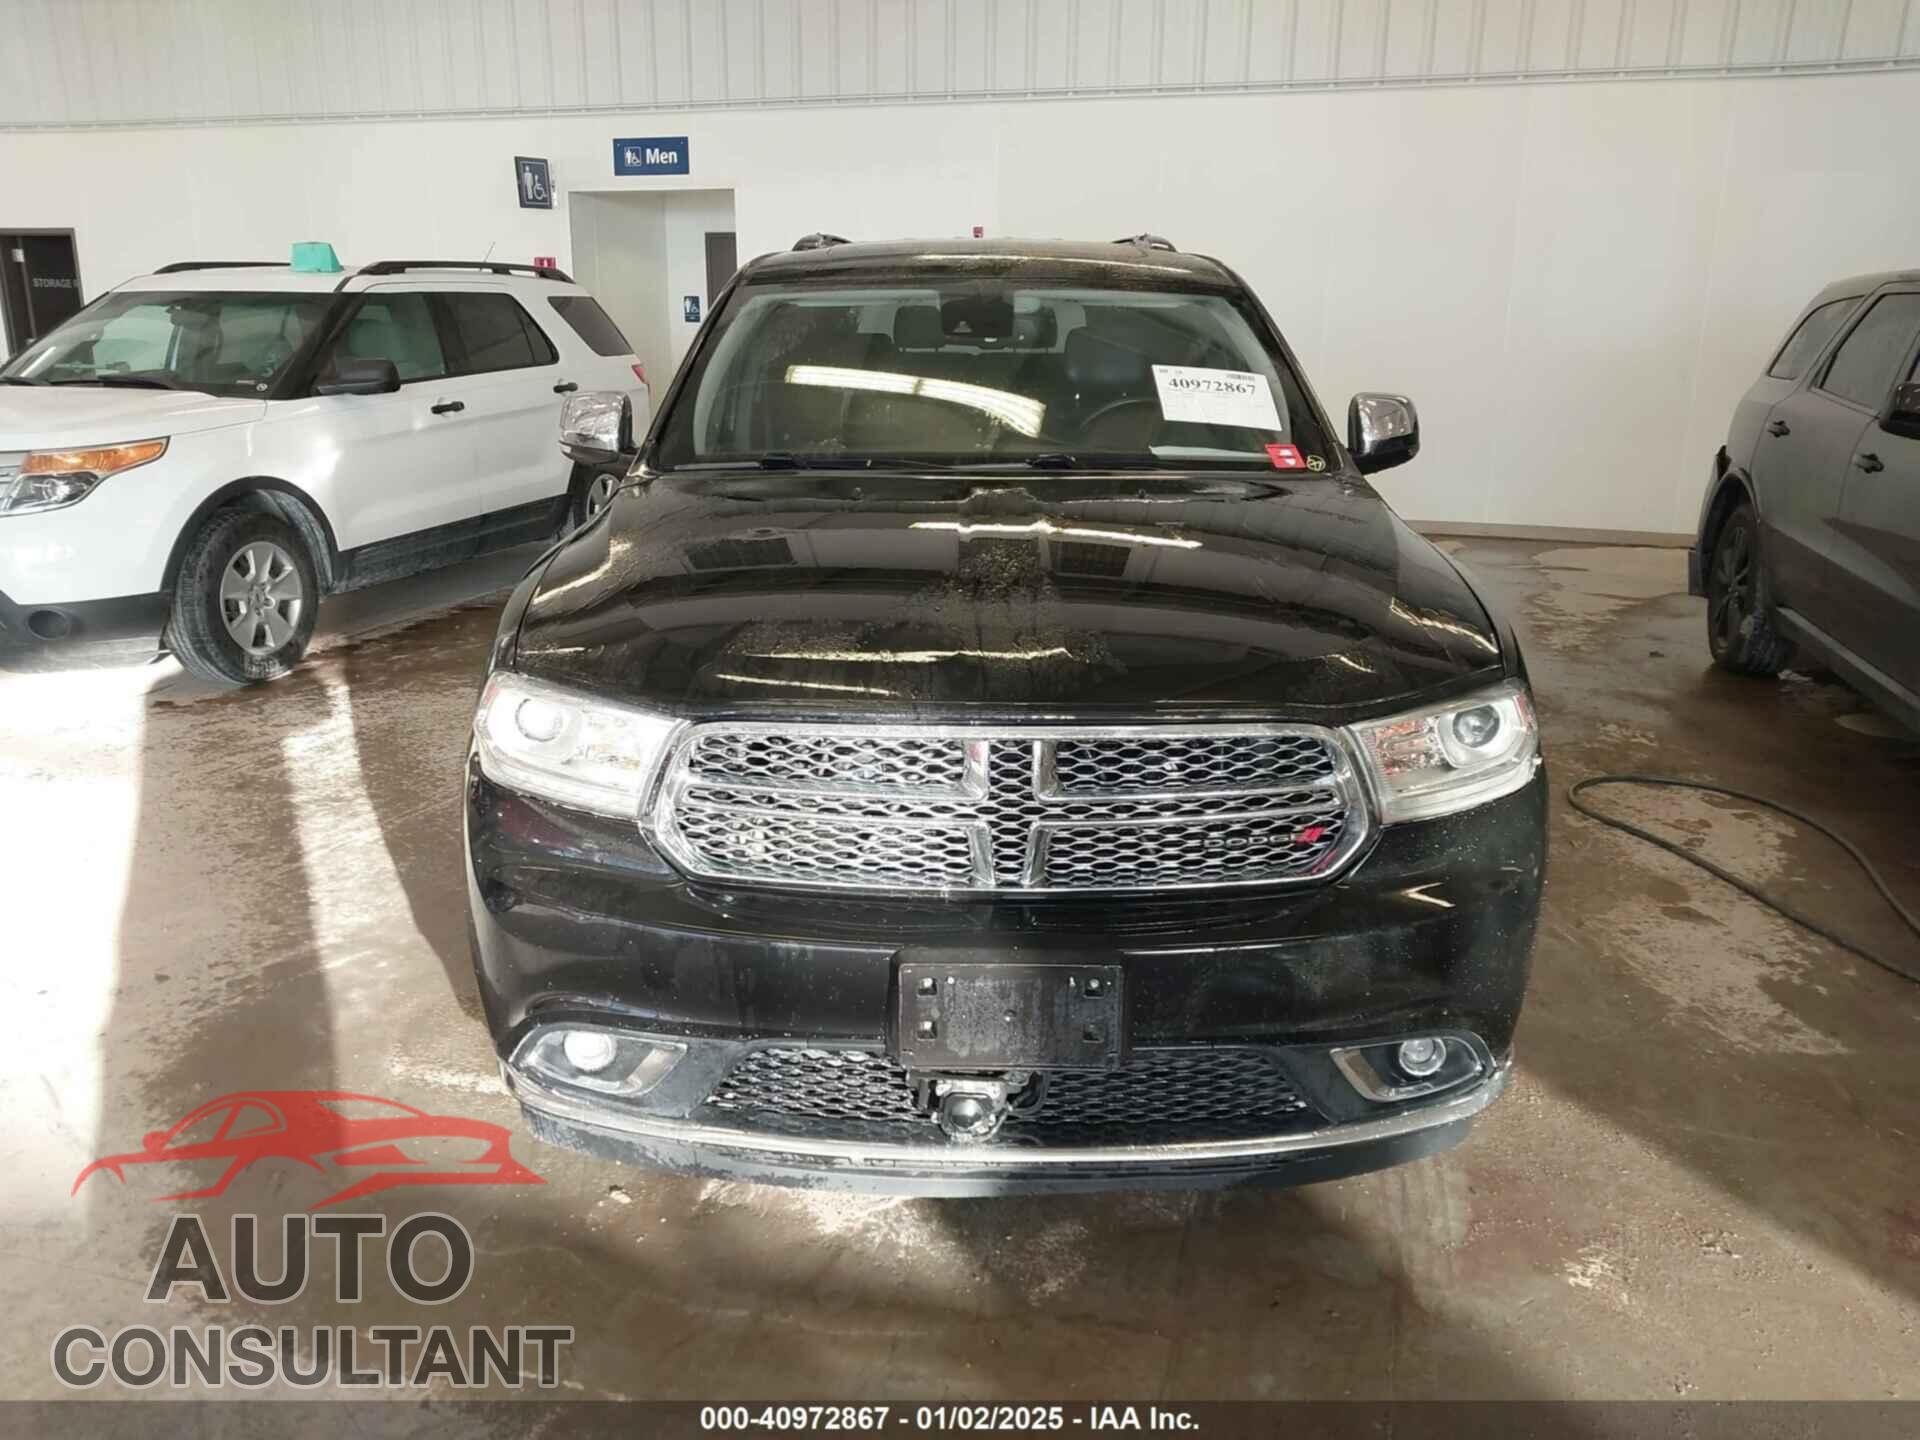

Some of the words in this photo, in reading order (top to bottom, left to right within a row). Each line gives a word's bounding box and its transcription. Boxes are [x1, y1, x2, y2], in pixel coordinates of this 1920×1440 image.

[645, 148, 679, 165] Men
[33, 278, 73, 289] STORAGE
[1169, 377, 1257, 395] 40972867
